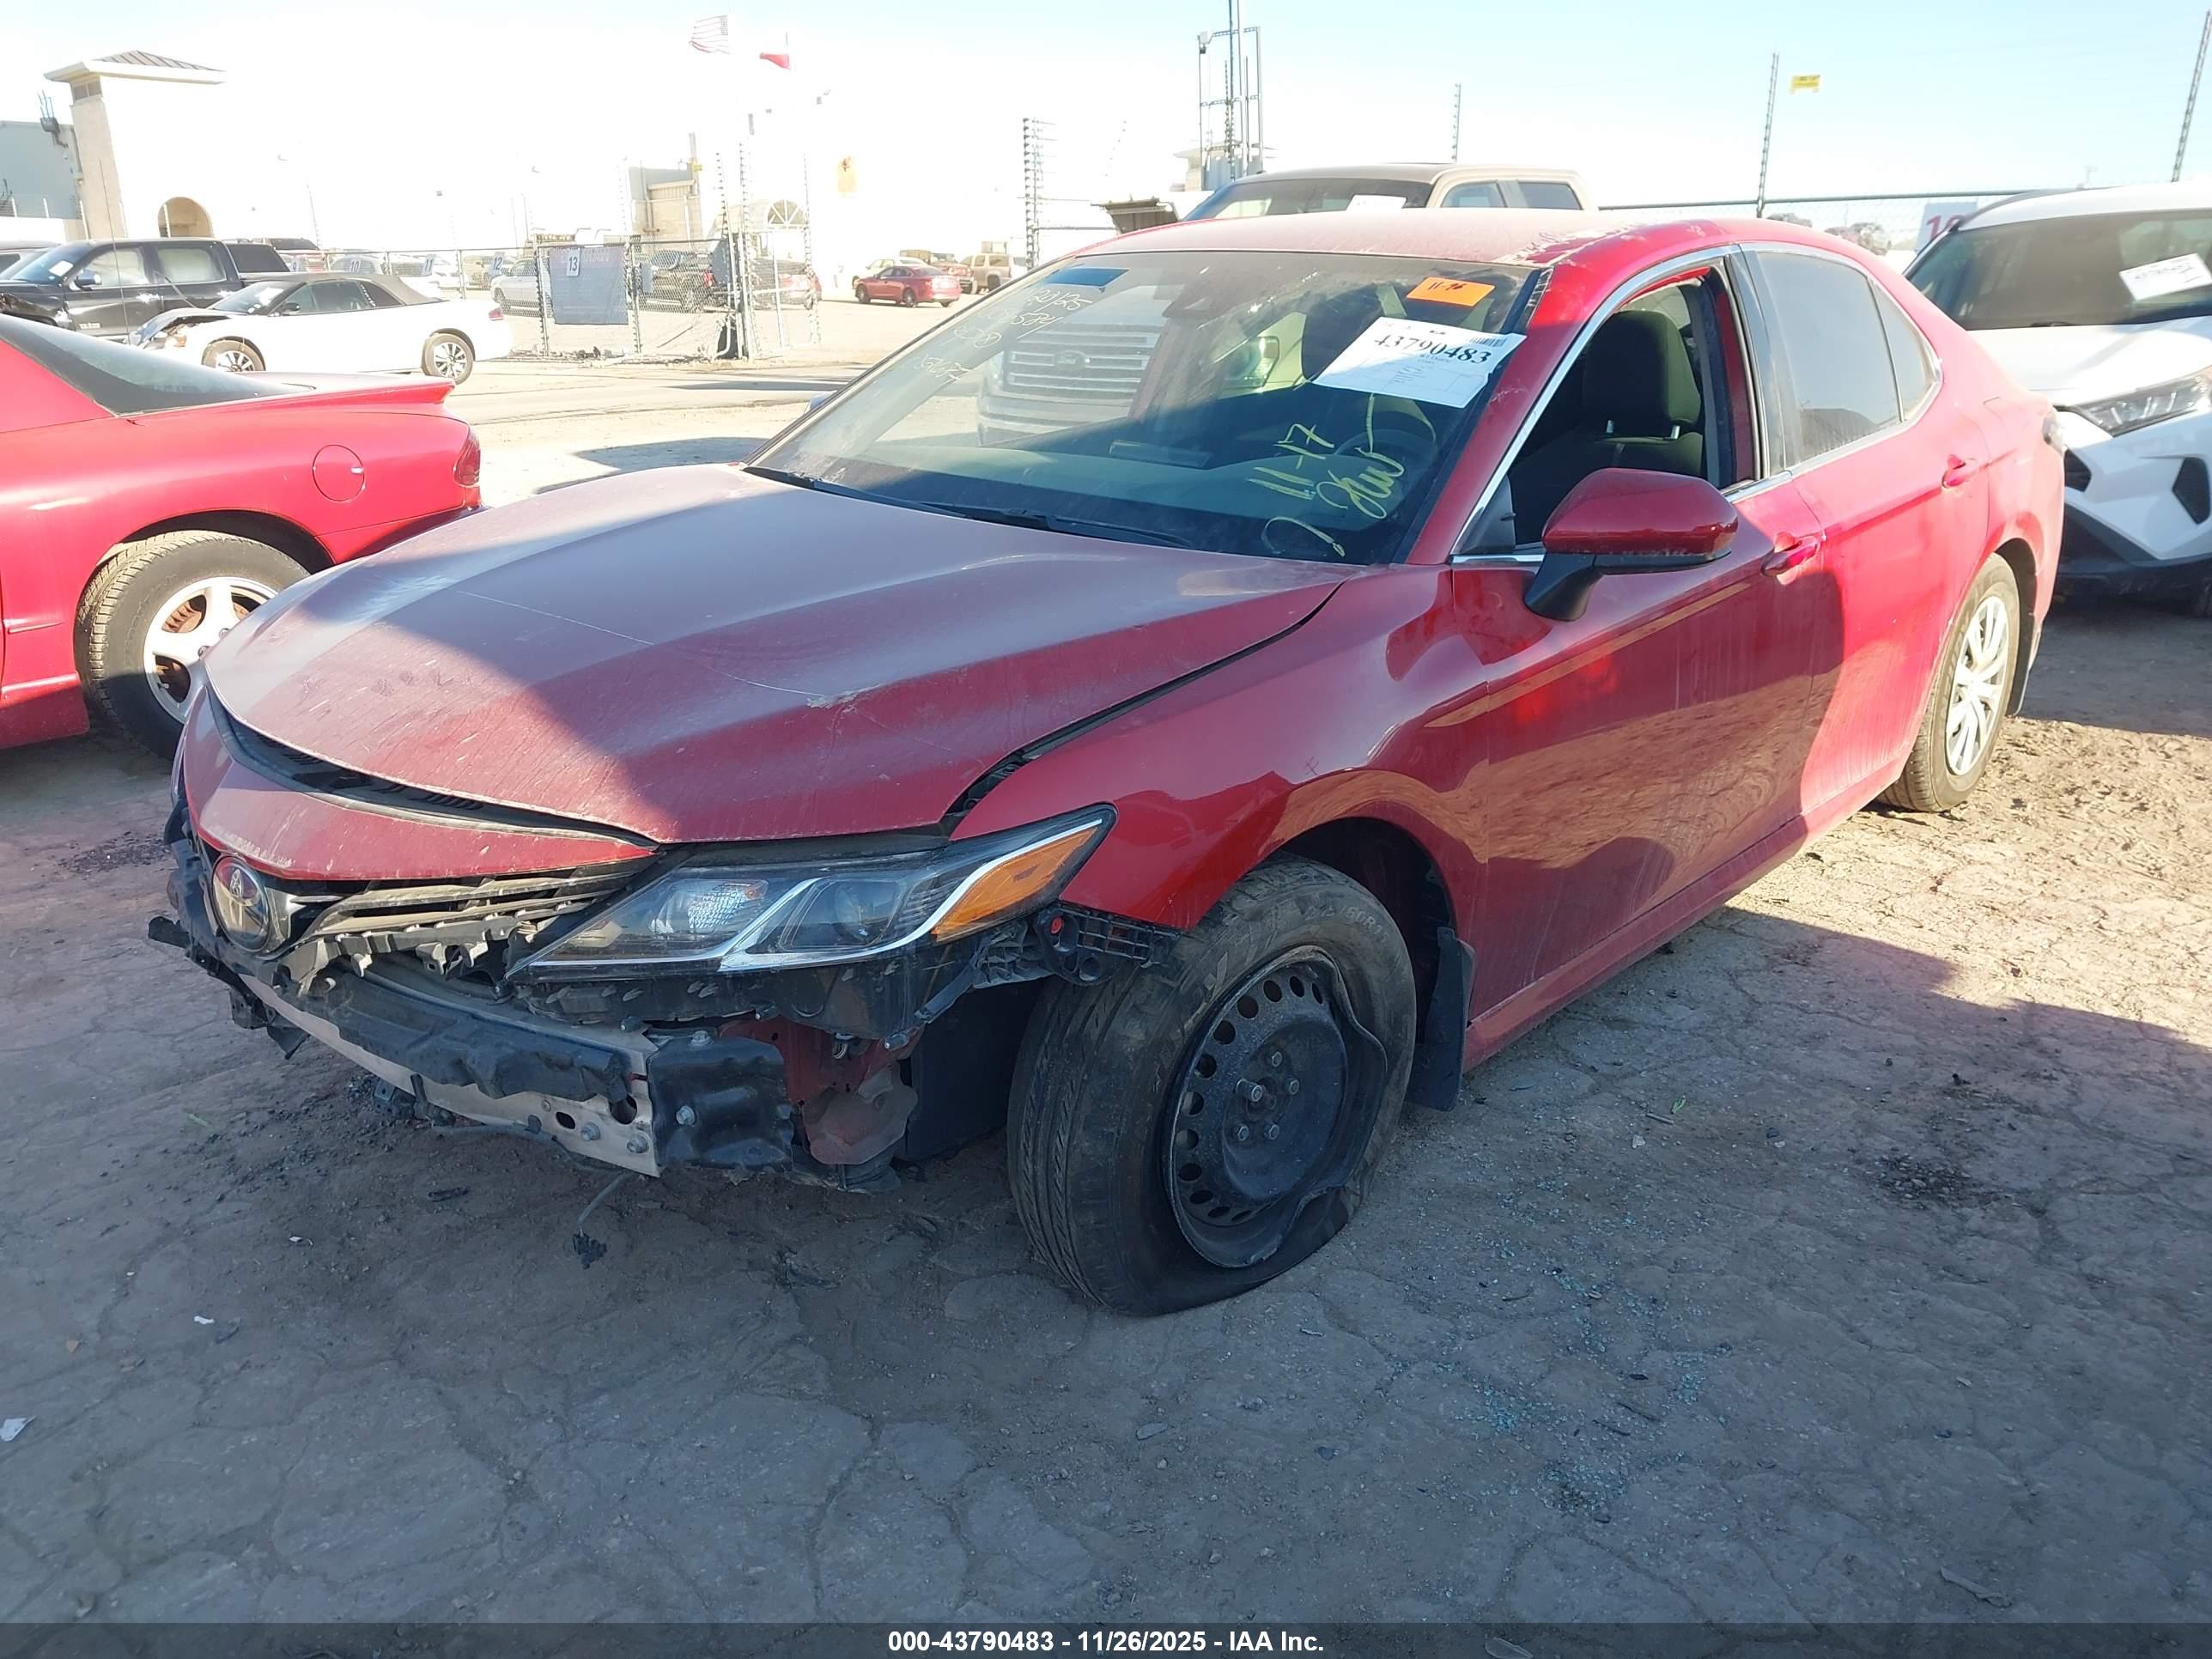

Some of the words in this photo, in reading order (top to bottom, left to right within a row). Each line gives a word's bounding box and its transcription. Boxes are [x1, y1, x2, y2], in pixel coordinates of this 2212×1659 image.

[425, 258, 433, 271] 11
[493, 258, 502, 270] 12
[568, 257, 578, 271] 13
[1374, 334, 1492, 364] 43790483
